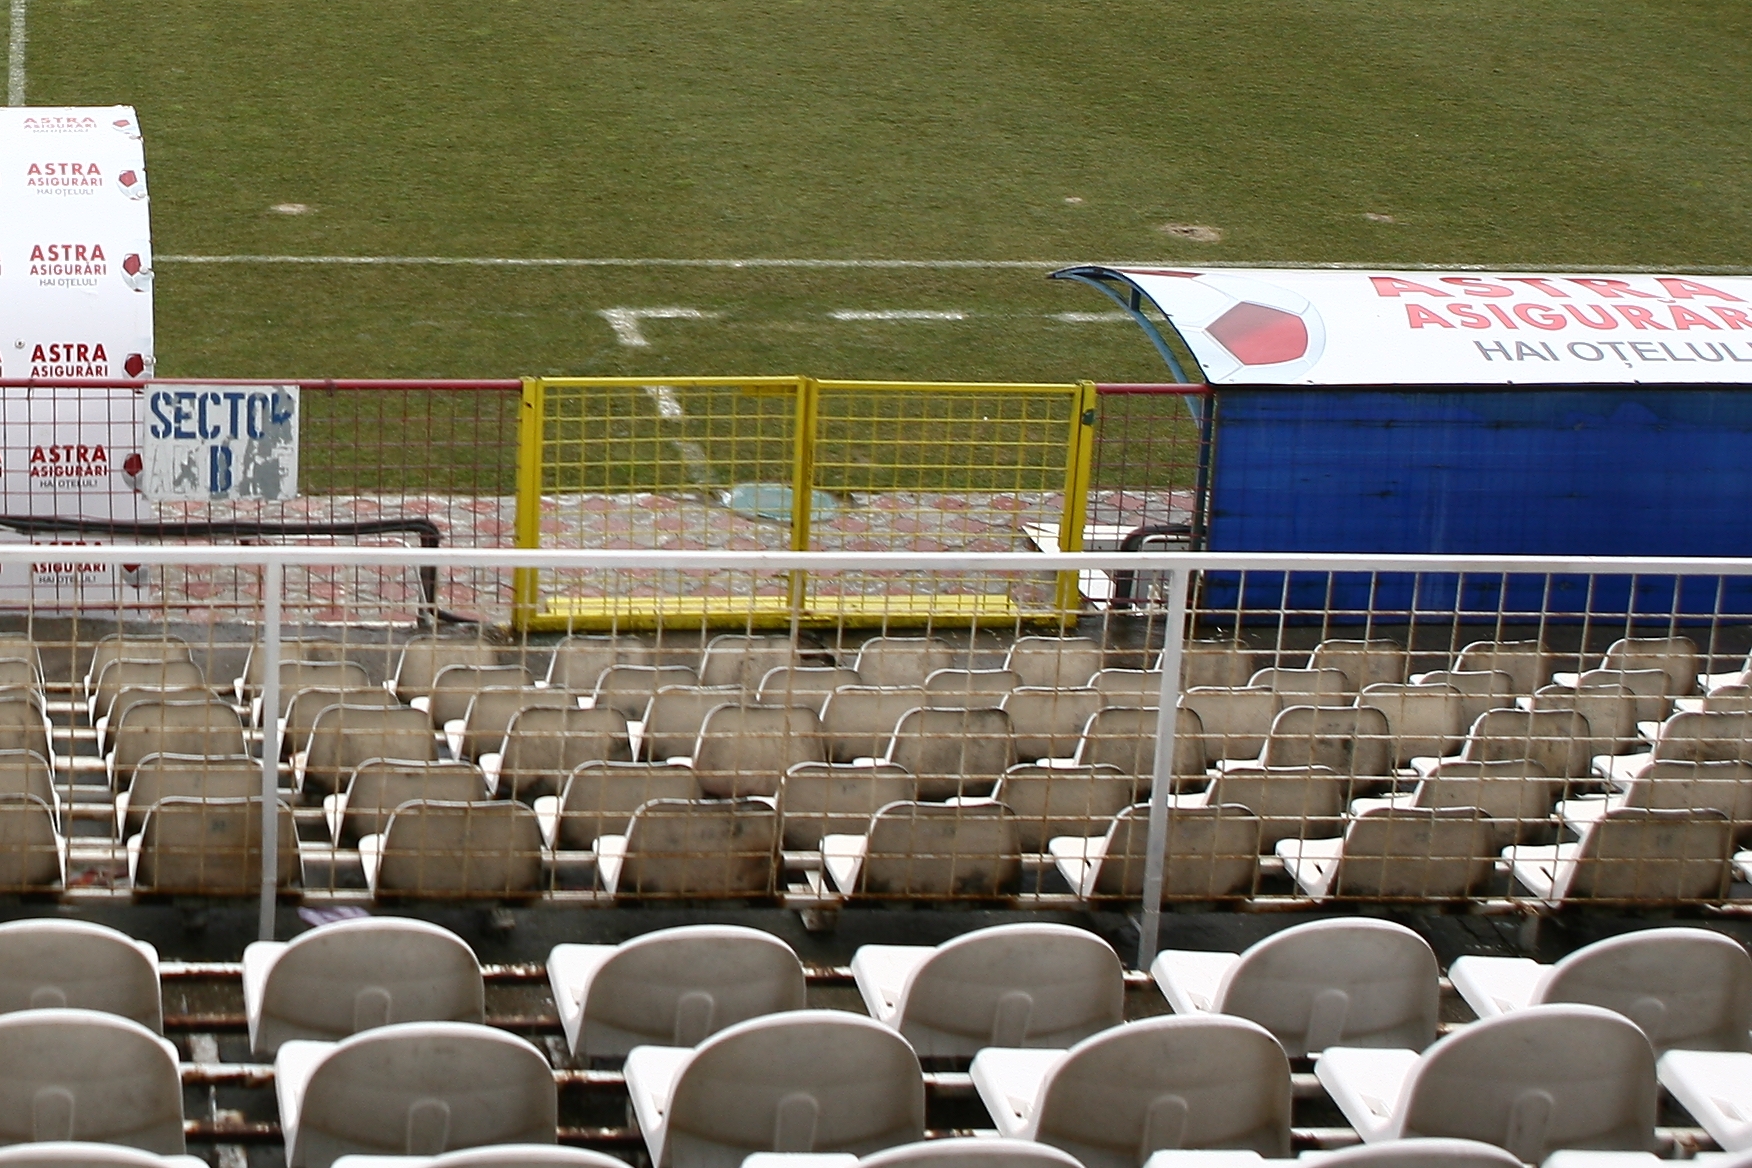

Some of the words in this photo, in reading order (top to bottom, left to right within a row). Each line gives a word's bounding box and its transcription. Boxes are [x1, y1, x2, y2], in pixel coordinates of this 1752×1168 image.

[27, 163, 102, 176] ASTRA
[30, 244, 106, 262] ASTRA
[39, 278, 56, 286] HAI
[1368, 276, 1749, 303] ASTRA
[1405, 299, 1752, 331] ASIGURĂR
[31, 343, 108, 363] ASTRA
[1473, 340, 1559, 362] HAI
[1566, 341, 1752, 369] OȚELUL
[30, 444, 107, 463] ASTRA
[40, 480, 56, 488] HA
